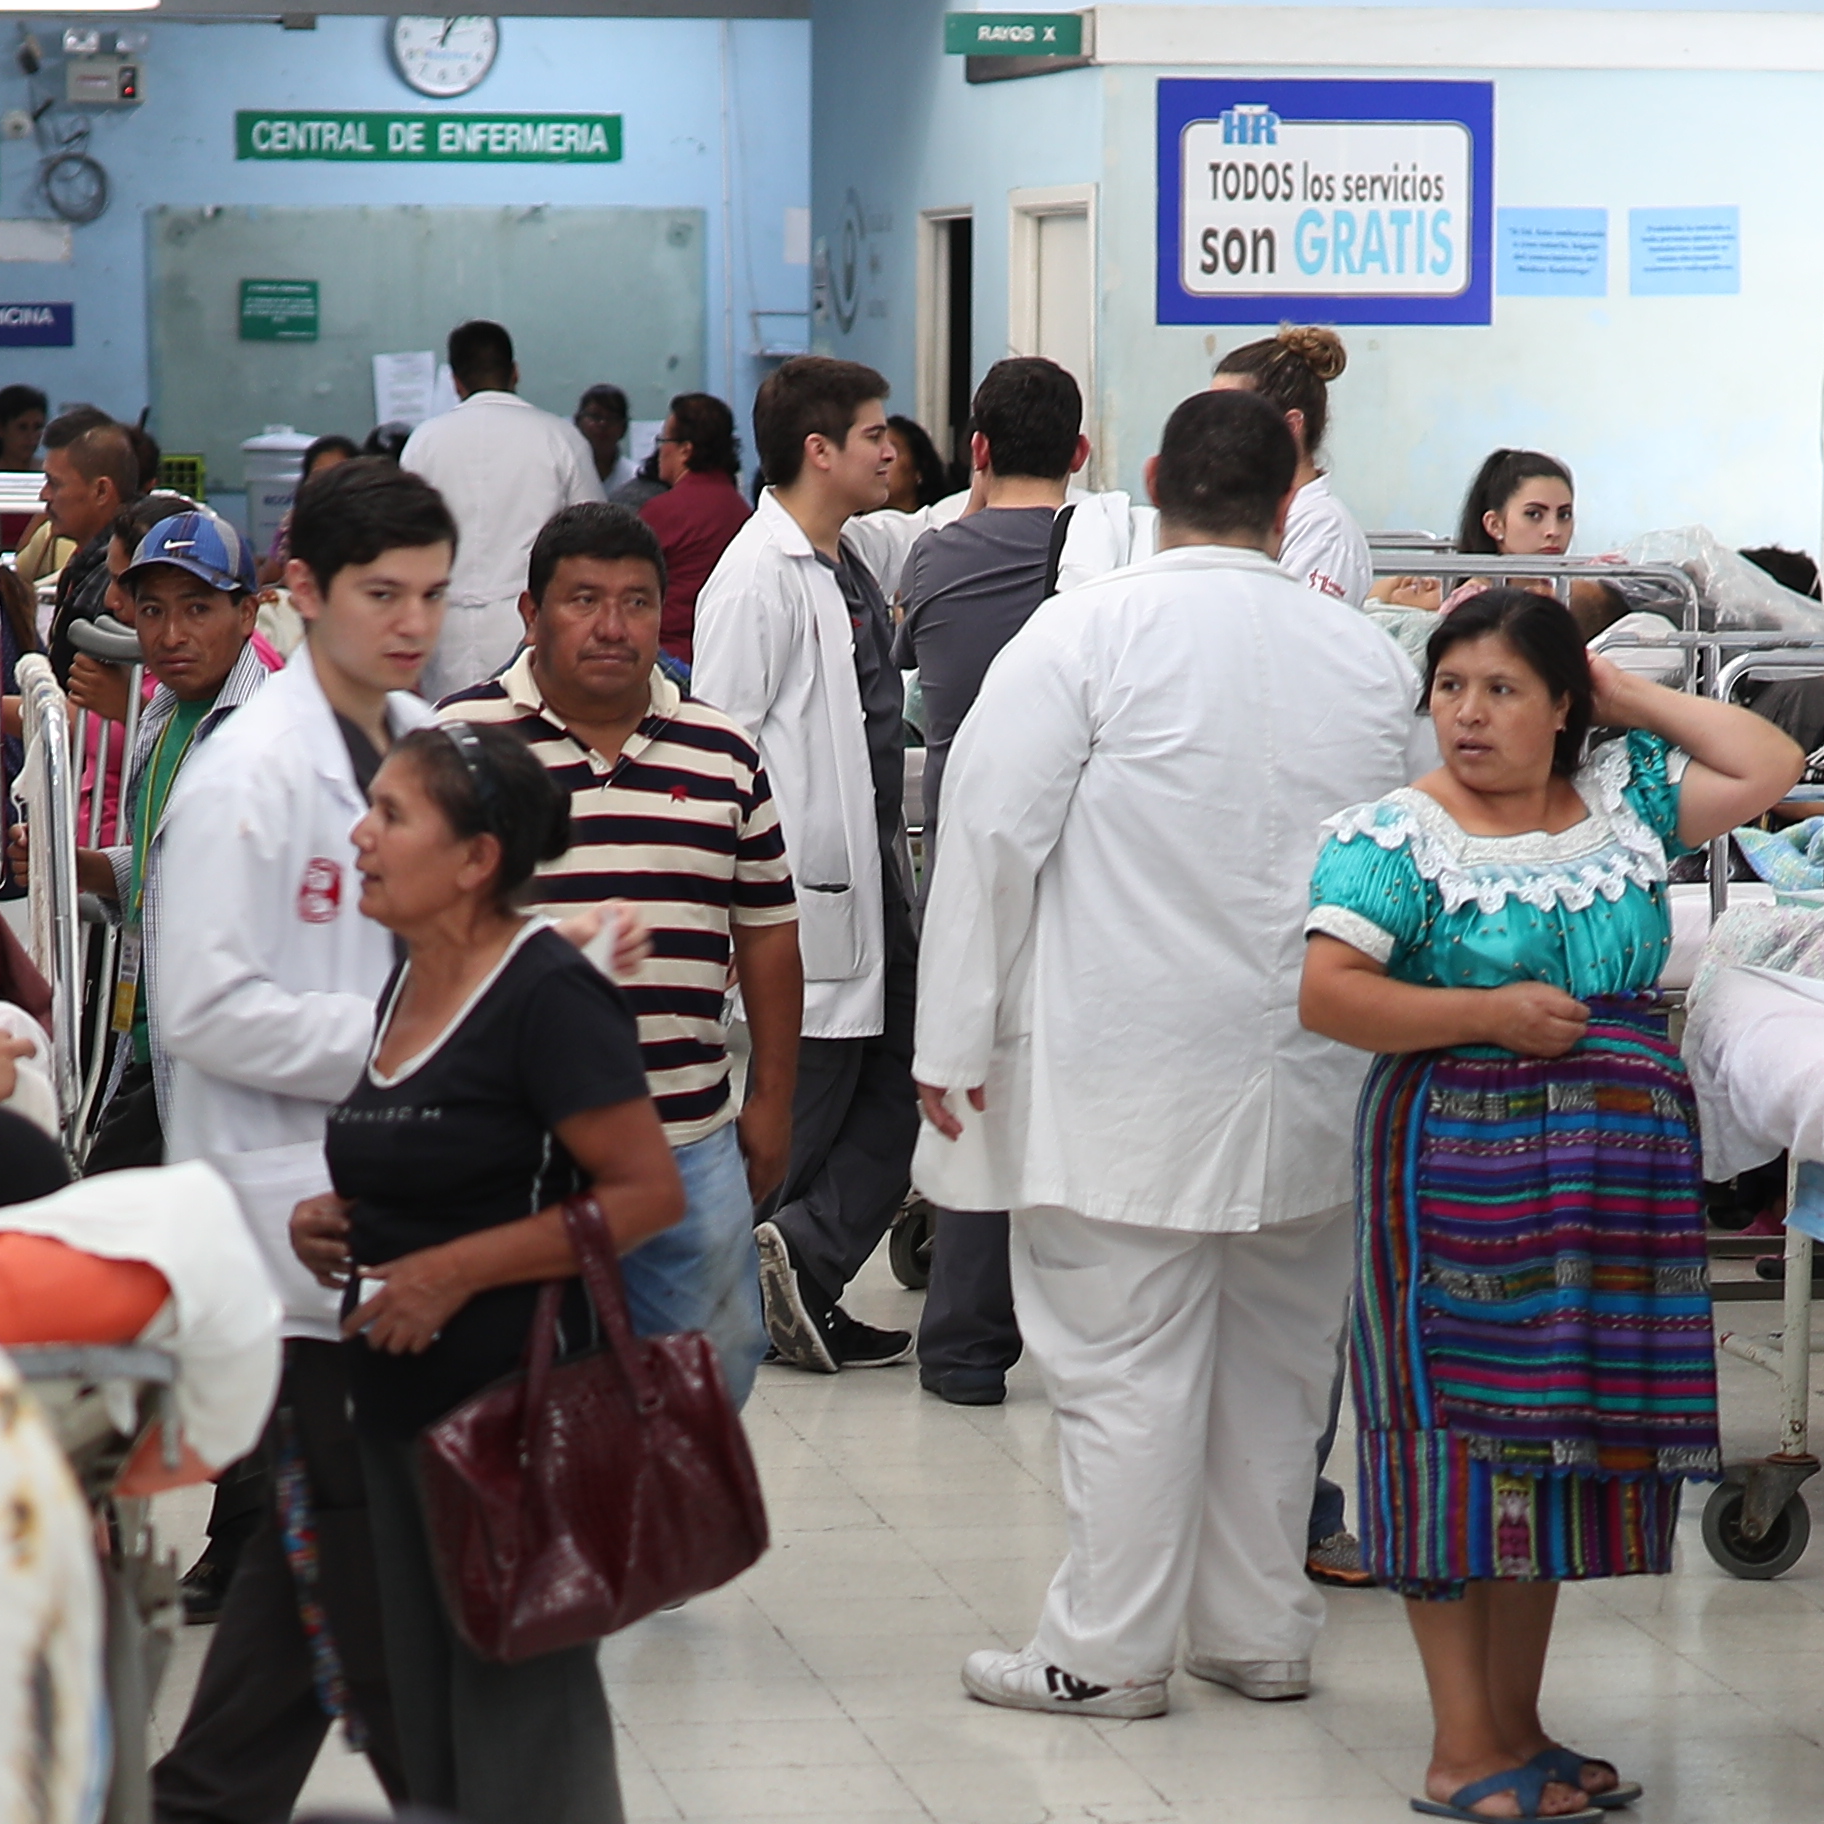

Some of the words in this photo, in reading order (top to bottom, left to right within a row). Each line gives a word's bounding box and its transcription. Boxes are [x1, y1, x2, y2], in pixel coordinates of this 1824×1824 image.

[978, 25, 1035, 41] RAYOS
[1043, 26, 1056, 41] X
[251, 120, 374, 152] CENTRAL
[387, 122, 425, 152] DE
[438, 122, 610, 153] ENFERMERIA
[1222, 110, 1279, 145] HR
[1209, 161, 1294, 202] TODOS
[1302, 160, 1335, 202] los
[1342, 163, 1445, 203] servicios
[1200, 226, 1276, 275] son
[1294, 208, 1453, 276] GRATIS
